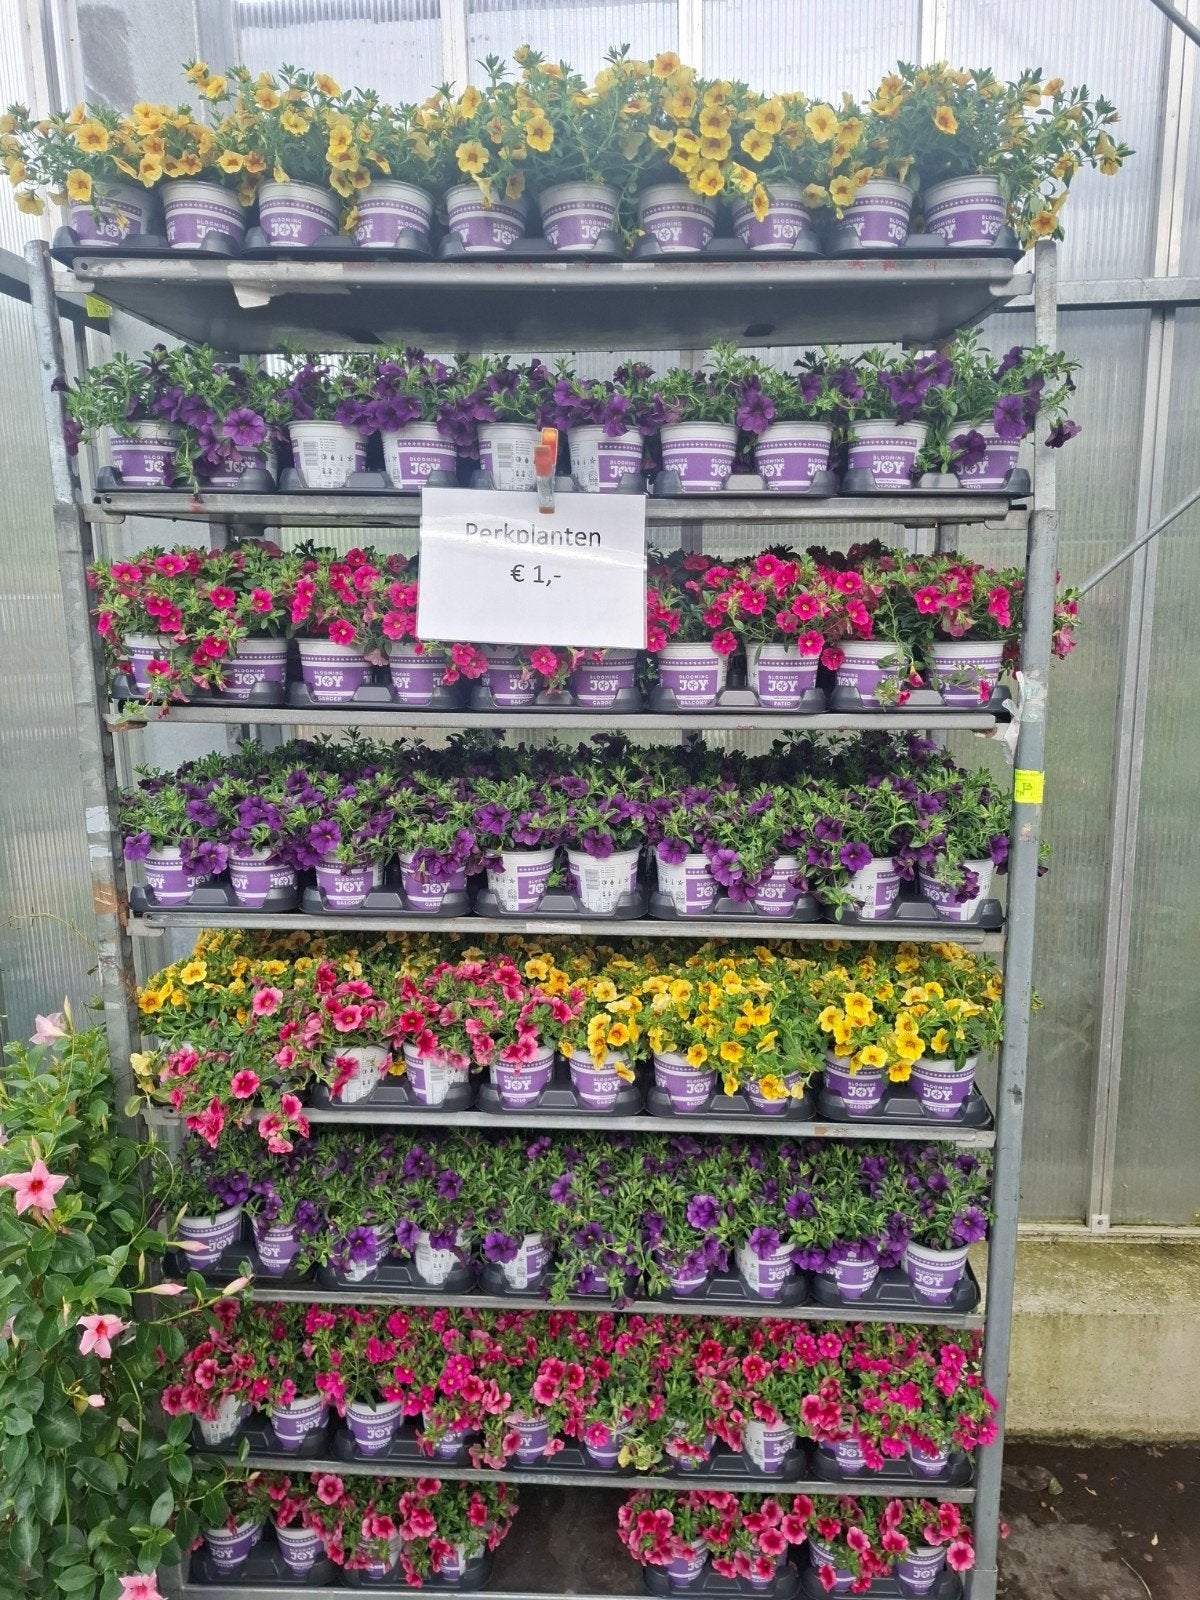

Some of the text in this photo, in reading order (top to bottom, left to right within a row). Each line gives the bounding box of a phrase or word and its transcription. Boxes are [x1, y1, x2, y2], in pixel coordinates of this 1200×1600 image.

[196, 220, 230, 232] BLOOMING
[773, 218, 802, 226] BLOOMING
[271, 223, 302, 238] JOY
[873, 461, 904, 474] JOY
[466, 522, 601, 547] Perkplanten
[510, 564, 562, 587] € 1,-
[315, 676, 344, 687] JOY
[590, 680, 618, 691] JOY
[680, 680, 709, 692] JOY
[768, 680, 798, 692] JOY
[335, 881, 364, 892] JOY
[422, 882, 450, 894] JOY
[758, 888, 786, 899] JOY
[924, 888, 950, 903] JOY
[504, 1080, 532, 1090] JOY
[594, 1080, 620, 1092] JOY
[686, 1082, 711, 1094] JOY
[848, 1086, 876, 1098] JOY
[924, 1087, 952, 1100] JOY
[208, 1234, 234, 1252] JOY
[768, 1268, 792, 1281] JOY
[915, 1272, 944, 1286] JOY
[296, 1419, 321, 1433] JOY
[367, 1426, 394, 1439] JOY
[290, 1550, 316, 1560] JOY
[913, 1568, 938, 1579] JOY
